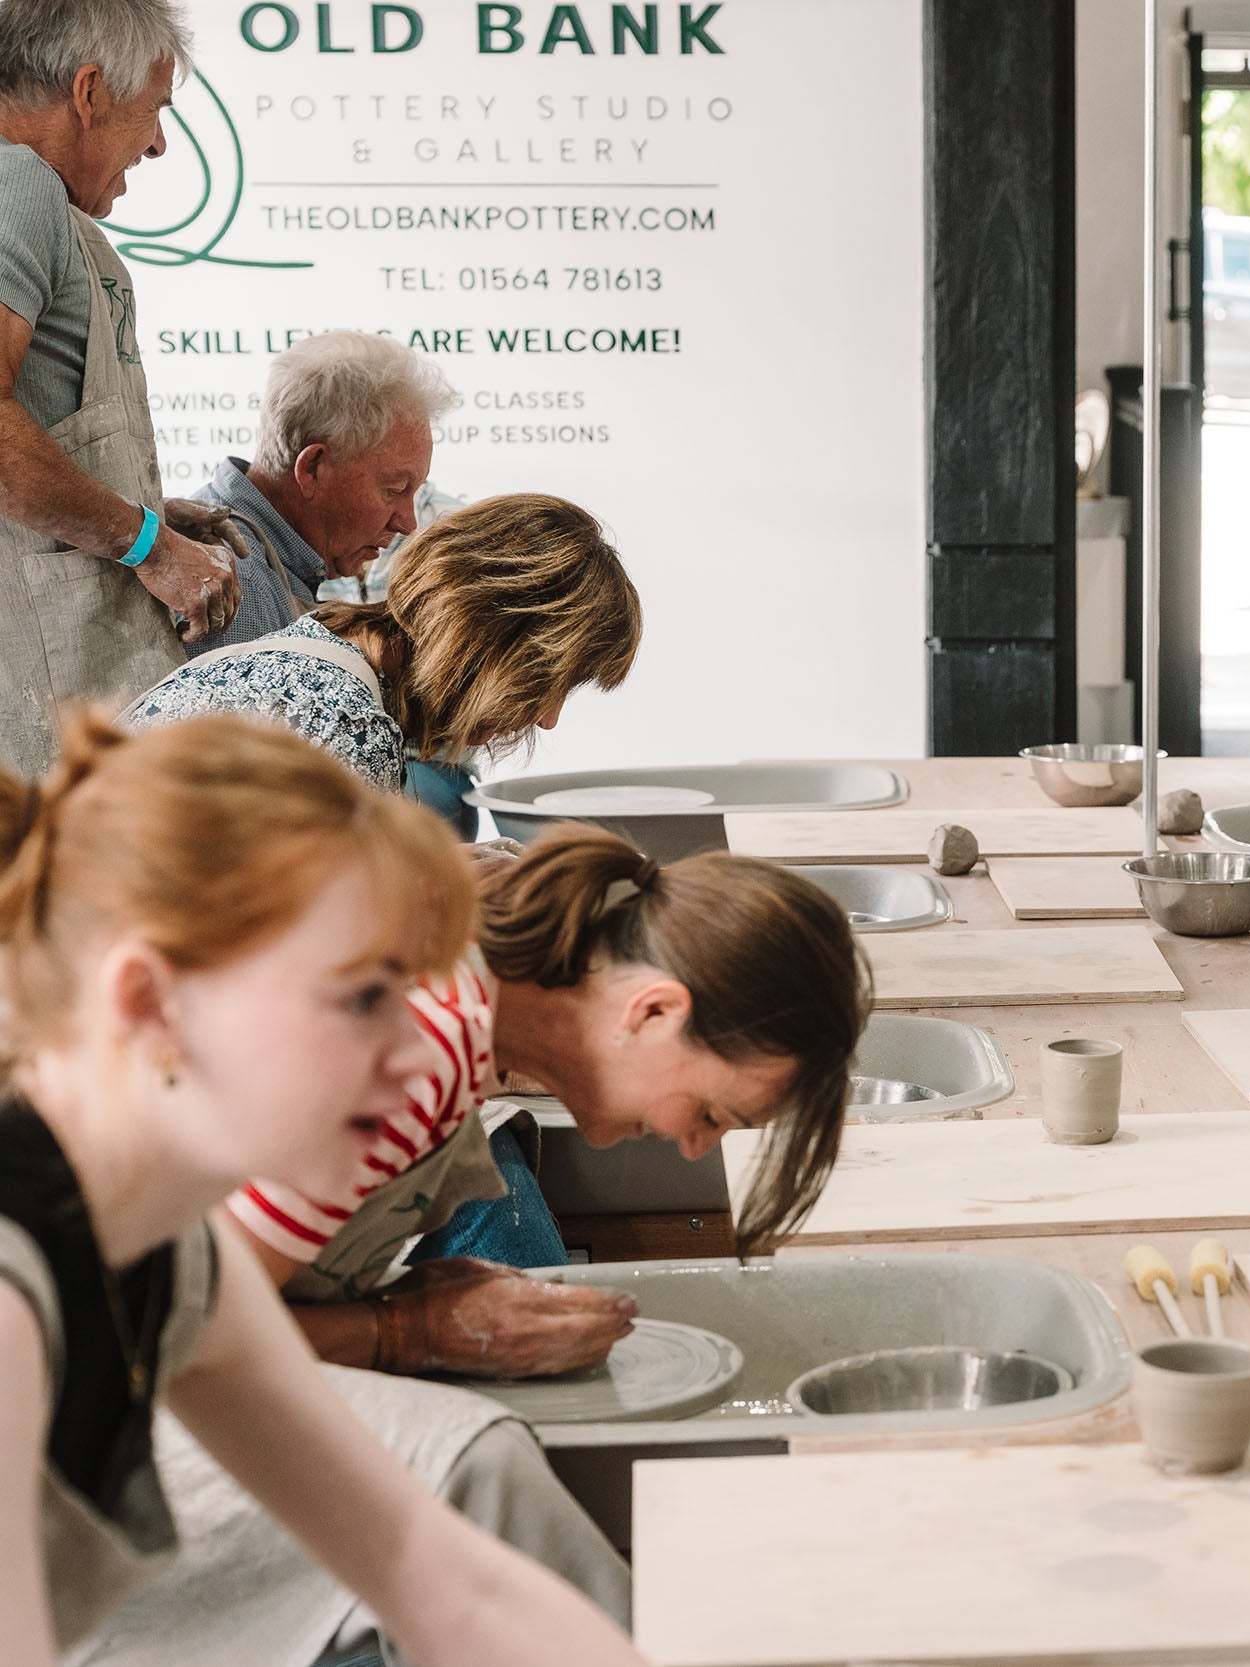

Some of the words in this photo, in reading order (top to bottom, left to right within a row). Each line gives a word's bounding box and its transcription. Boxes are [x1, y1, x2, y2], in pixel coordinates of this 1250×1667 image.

[241, 2, 424, 52] OLD
[478, 3, 726, 54] BANK
[256, 94, 496, 121] POTTERY
[538, 95, 733, 121] STUDIO
[352, 139, 372, 164] &
[414, 137, 648, 163] GALLERY
[261, 206, 716, 230] THEOLDBANKPOTTERY.COM
[380, 267, 445, 291] TEL:
[459, 267, 549, 291] 01564
[564, 268, 662, 291] 781613
[158, 329, 251, 354] SKILL
[408, 329, 474, 353] ARE
[488, 329, 681, 353] WELCOME!
[474, 391, 585, 410] CLASSES
[490, 425, 610, 443] SESSIONS
